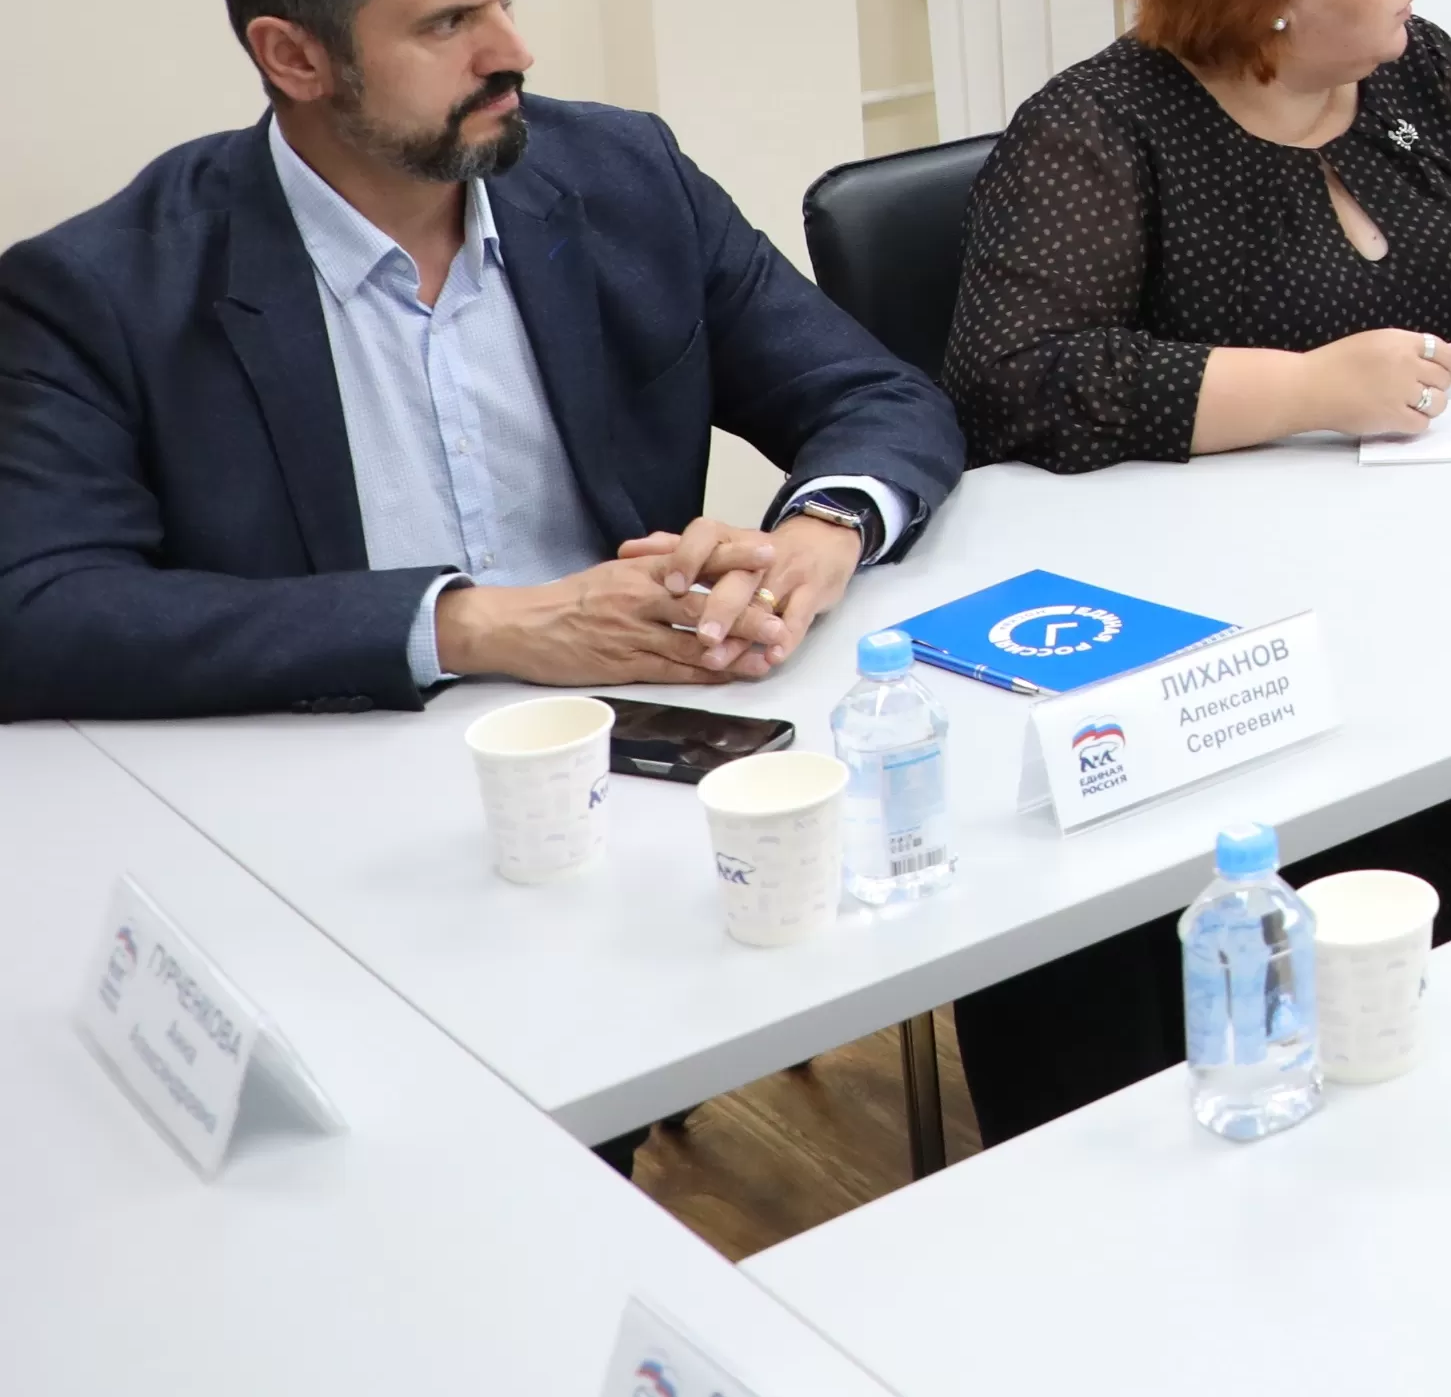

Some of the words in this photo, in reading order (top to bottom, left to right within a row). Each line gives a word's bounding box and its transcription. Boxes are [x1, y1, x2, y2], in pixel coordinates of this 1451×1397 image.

[1160, 638, 1289, 700] ЛИХАНОВ
[1180, 675, 1289, 727] Александр
[1187, 704, 1295, 753] Сергеевич
[1079, 765, 1124, 787] ЕДИНАЯ
[1082, 774, 1127, 797] РОССИЯ
